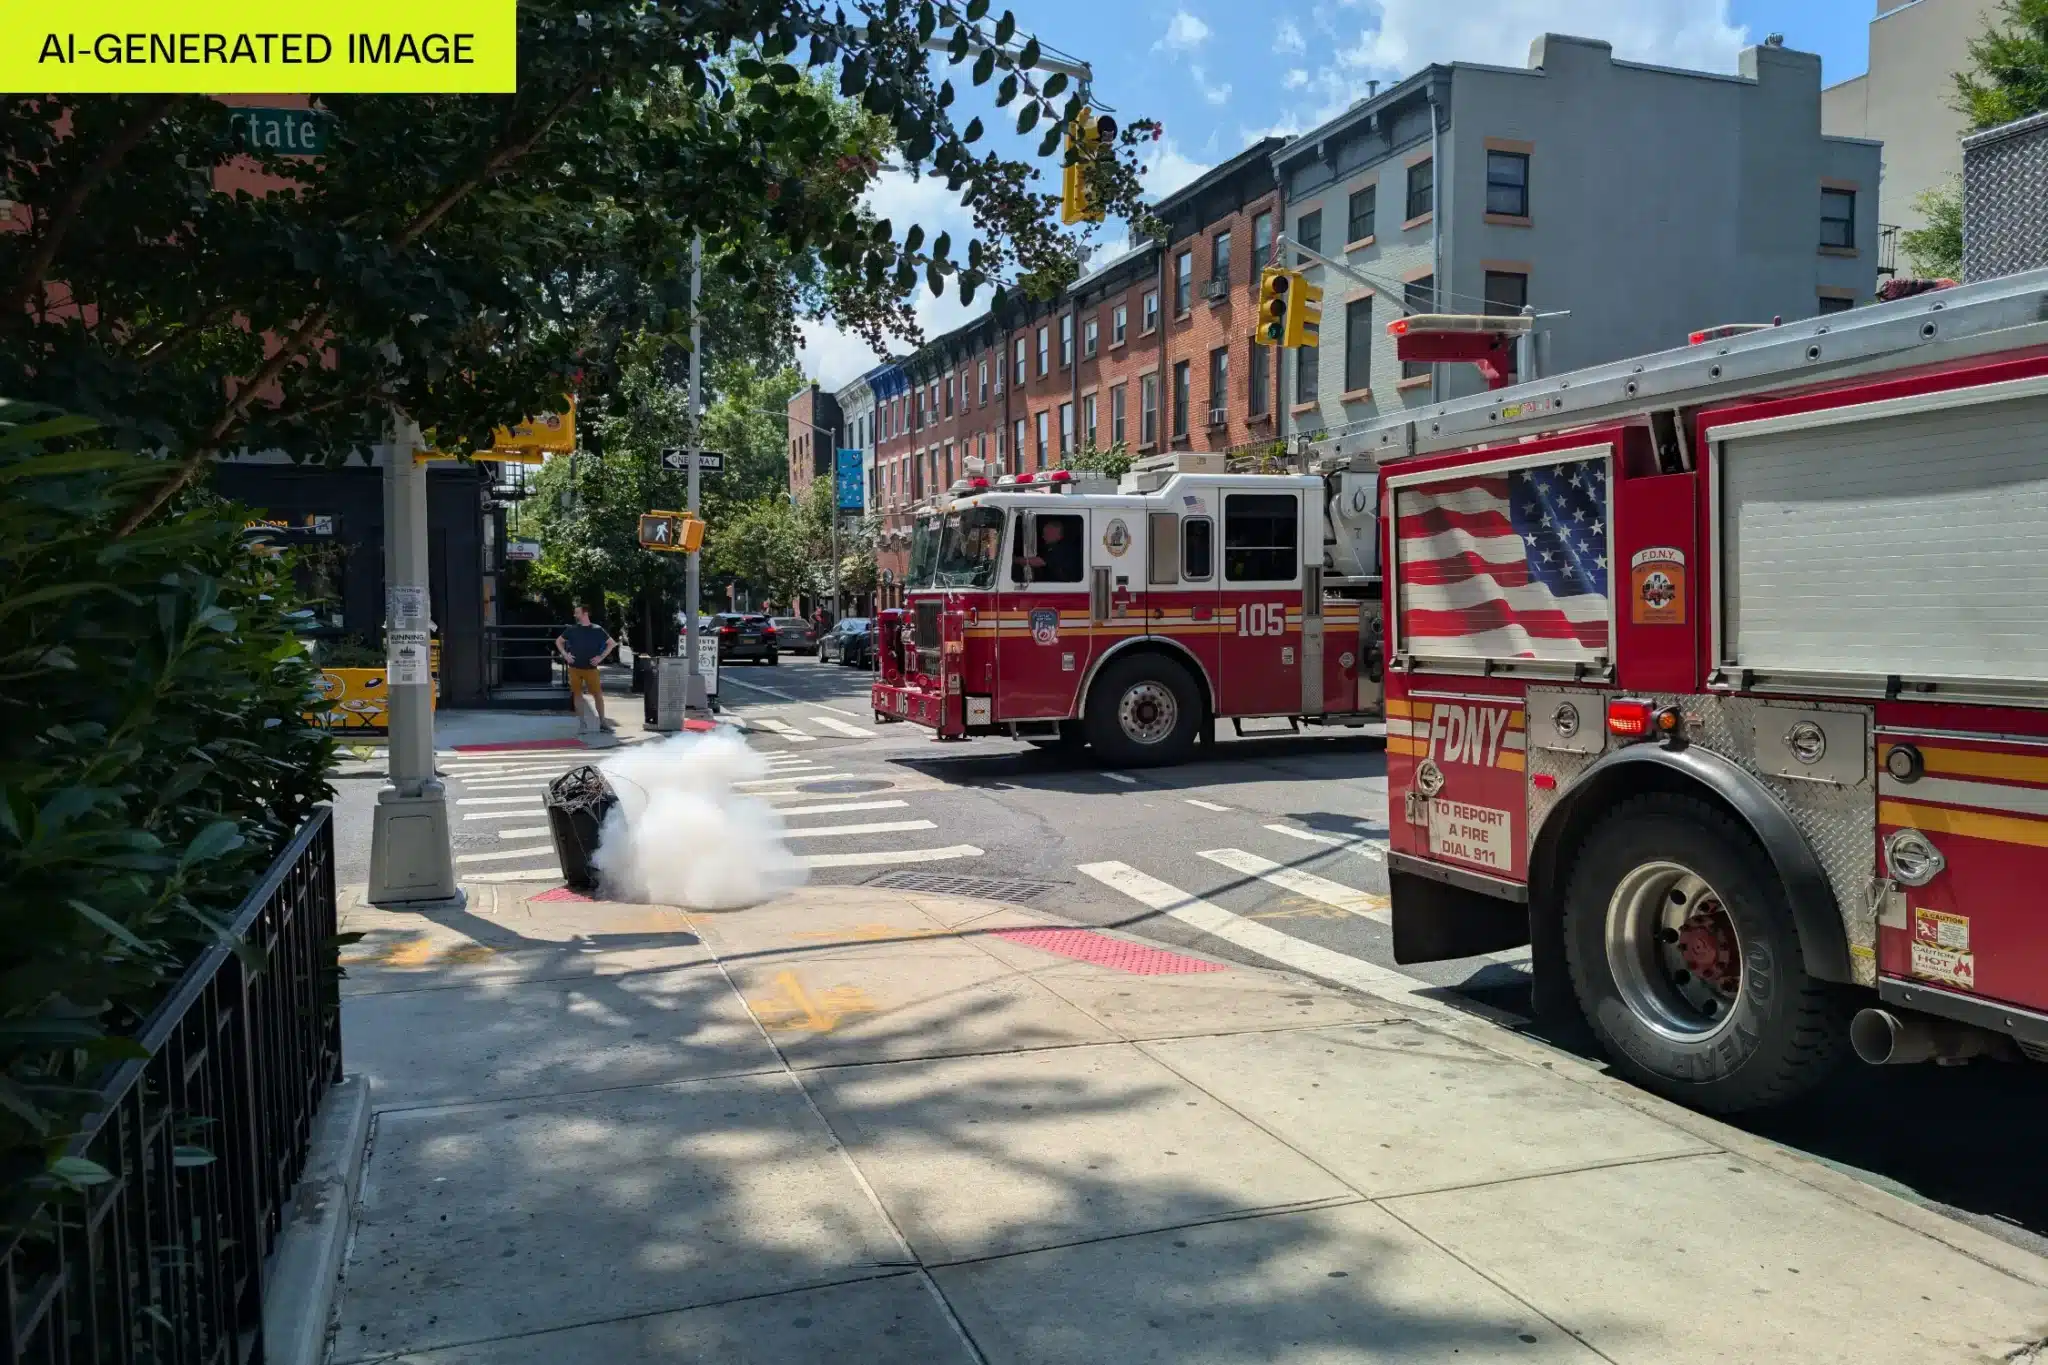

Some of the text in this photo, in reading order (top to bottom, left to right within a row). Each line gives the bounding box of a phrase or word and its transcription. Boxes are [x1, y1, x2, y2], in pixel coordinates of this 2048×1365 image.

[671, 455, 689, 464] ONE
[1641, 550, 1676, 561] F.D.N.Y.
[1238, 603, 1284, 637] 105
[896, 691, 909, 715] 105
[1428, 703, 1508, 767] FDNY
[1434, 800, 1504, 827] TO REPORT
[1448, 825, 1489, 844] A FIRE
[1442, 840, 1496, 865] DIAL 911
[1930, 914, 1963, 925] CAUTION
[1917, 954, 1949, 967] HOT
